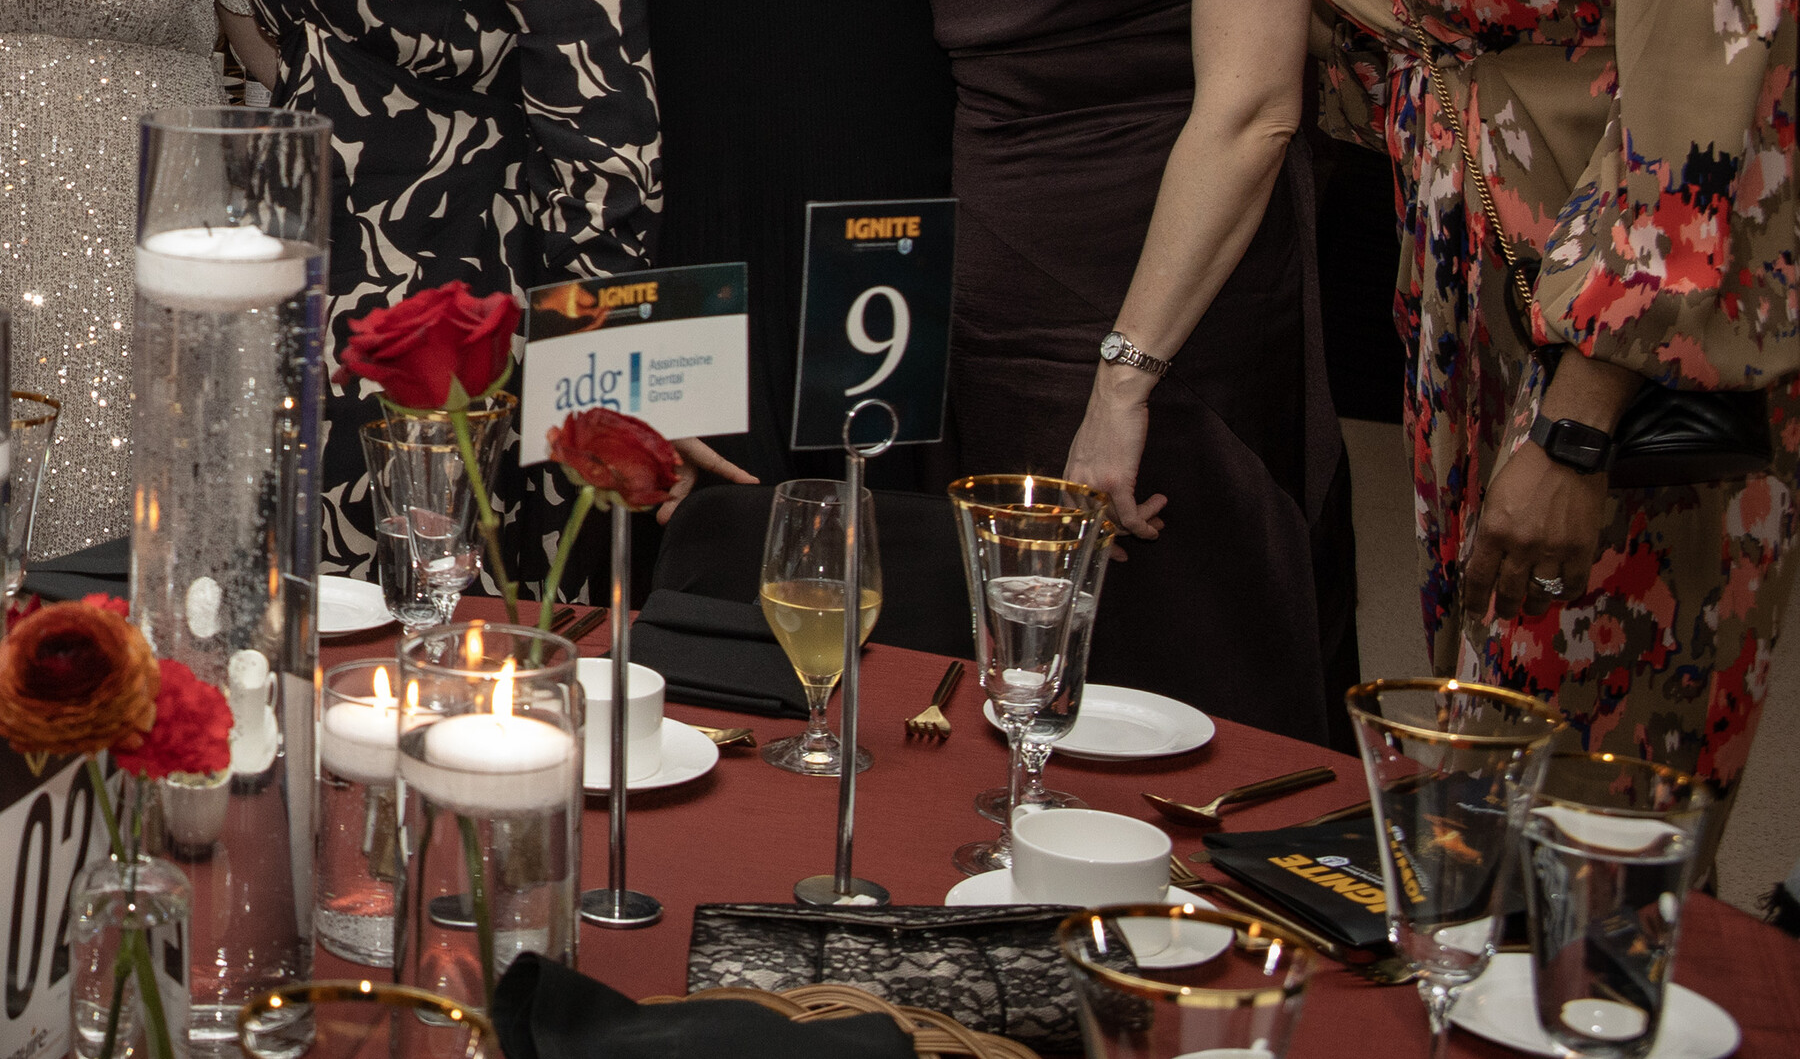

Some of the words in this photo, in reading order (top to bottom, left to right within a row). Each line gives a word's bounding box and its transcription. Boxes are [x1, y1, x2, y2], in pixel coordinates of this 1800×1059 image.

[845, 215, 922, 240] IGNITE
[598, 282, 659, 308] IGNITE
[843, 285, 913, 397] 9
[648, 354, 713, 371] Assiniboine
[555, 352, 623, 413] adg
[648, 373, 684, 387] Dental
[648, 389, 683, 403] Group
[1267, 853, 1388, 914] IGNITE
